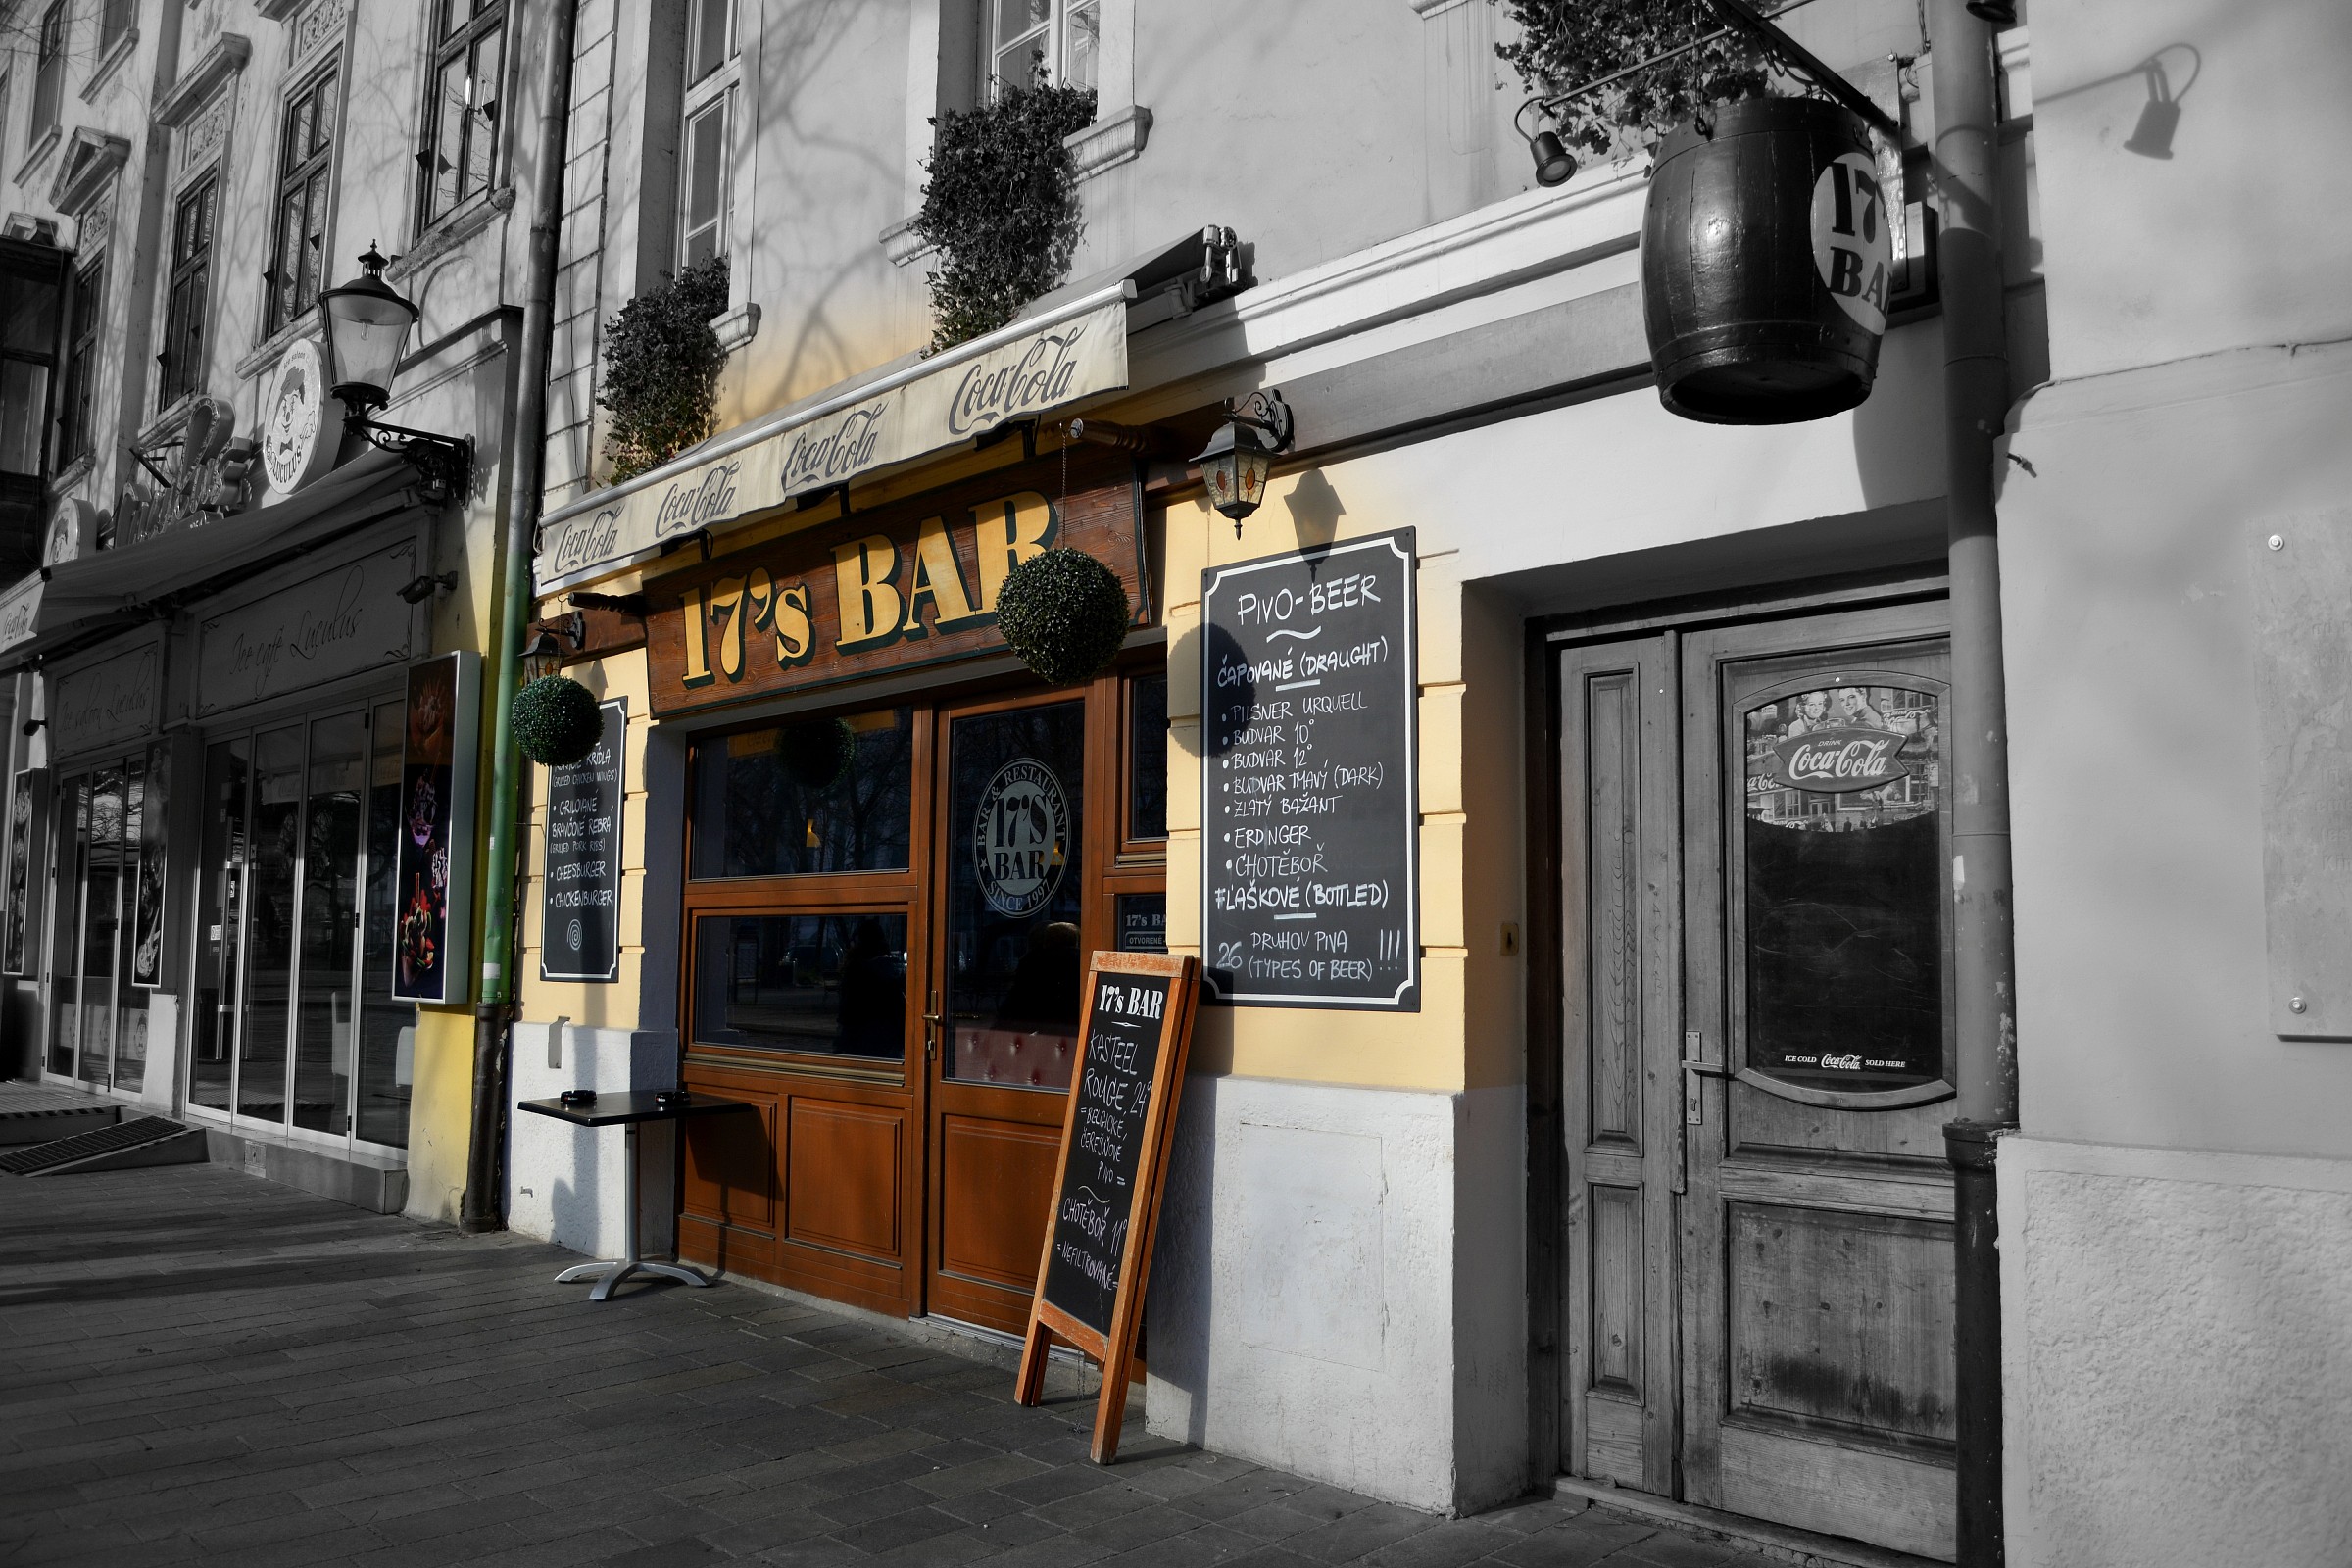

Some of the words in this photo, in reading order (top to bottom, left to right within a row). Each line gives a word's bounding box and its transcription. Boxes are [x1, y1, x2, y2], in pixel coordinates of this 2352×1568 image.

[1300, 635, 1389, 678] (DRAUGHT)
[1231, 701, 1294, 723] PILSNER
[1302, 691, 1369, 716] URQUELL
[1233, 725, 1286, 745] BUDVAR
[1231, 749, 1286, 769] BUDVAR
[1788, 739, 1890, 781] Coca-Cola
[1233, 773, 1286, 795] BUDVAR
[1334, 761, 1384, 790] (DARK)
[977, 807, 991, 846] BAR
[994, 850, 1045, 881] BAR
[1305, 879, 1389, 908] (BOTTLED)
[1216, 941, 1243, 970] 26
[1249, 955, 1302, 979] (TYPES
[1308, 959, 1326, 979] OF
[1330, 957, 1373, 982] BEER)
[1126, 987, 1164, 1020] BAR
[1088, 1028, 1139, 1076] KASTEEL
